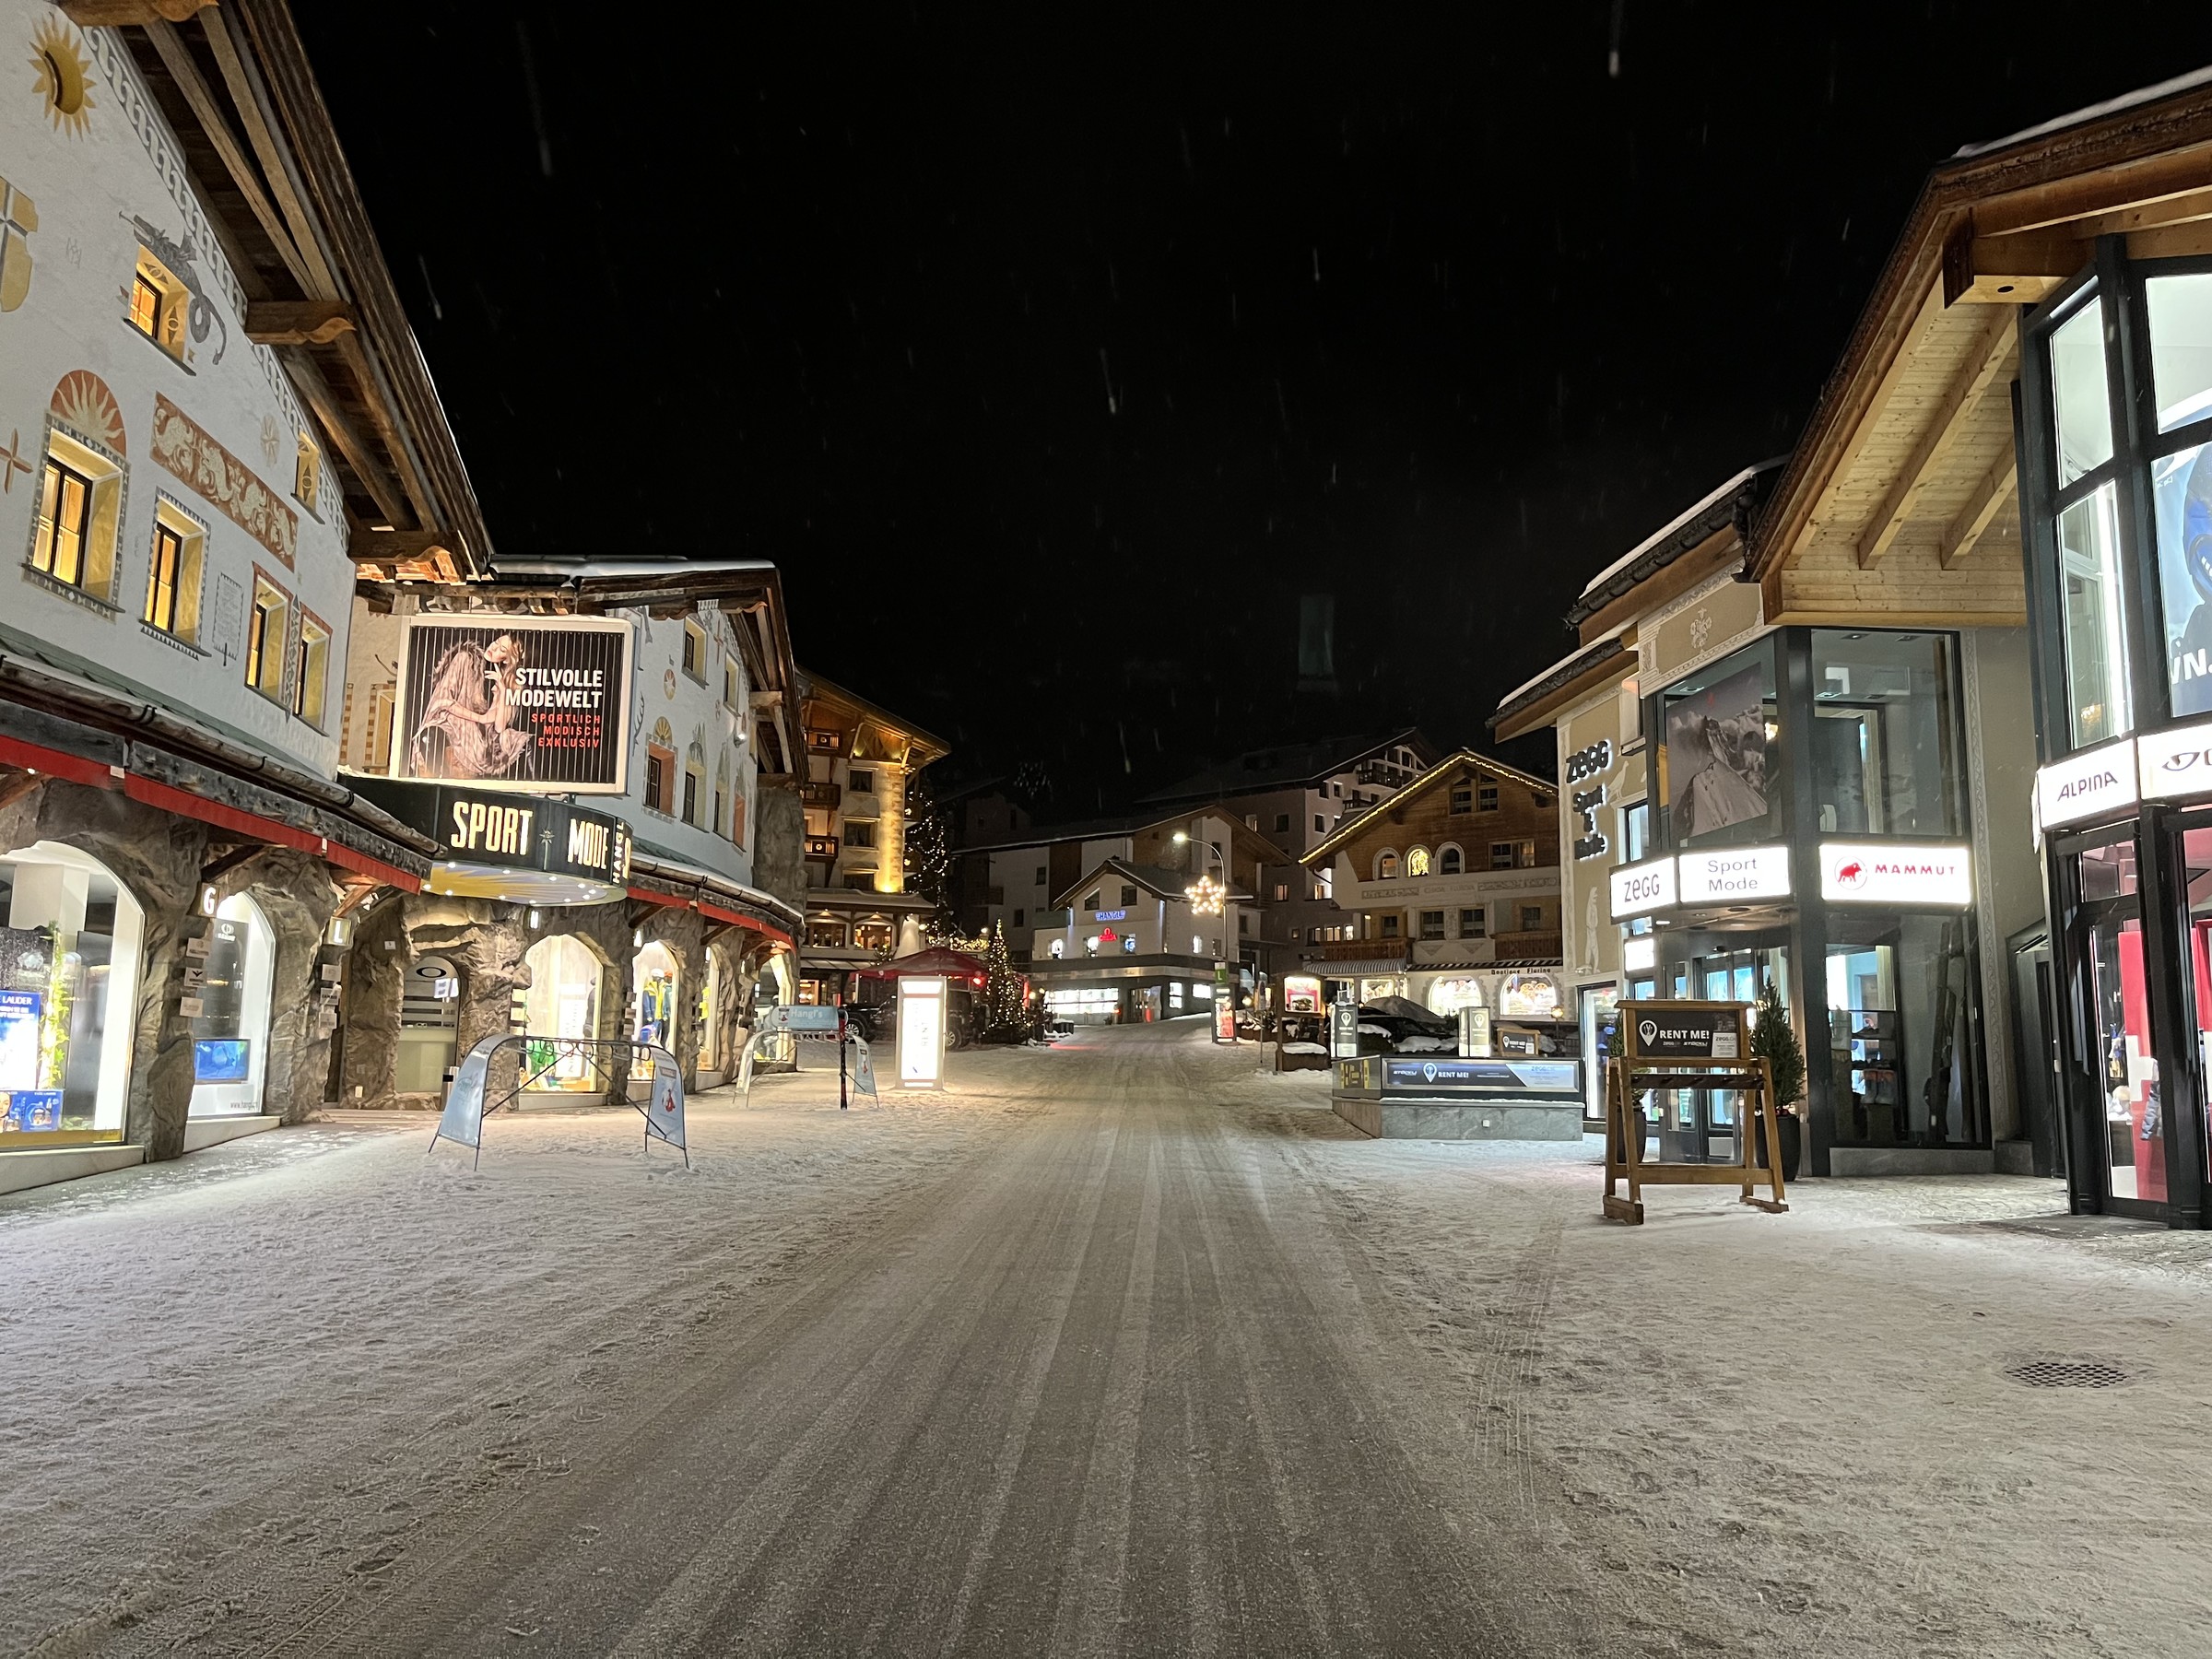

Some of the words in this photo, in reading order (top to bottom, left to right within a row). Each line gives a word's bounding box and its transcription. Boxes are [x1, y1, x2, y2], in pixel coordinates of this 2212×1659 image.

[515, 668, 603, 688] STILVOLLE
[505, 688, 603, 708] MODEWELT
[531, 713, 600, 724] SPORTLICH
[543, 725, 600, 735] MODISCH
[537, 737, 599, 747] EXKLUSIV
[2057, 771, 2119, 802] ALPINA
[451, 801, 534, 855] SPORT
[567, 818, 609, 870] MODE
[612, 821, 624, 884] HANGL
[1708, 858, 1758, 876] Sport
[1875, 864, 1955, 876] MAMMUT
[1709, 877, 1759, 892] Mode
[2, 996, 32, 1005] LAUDER
[1660, 1030, 1688, 1040] RENT
[1689, 1030, 1710, 1040] ME!
